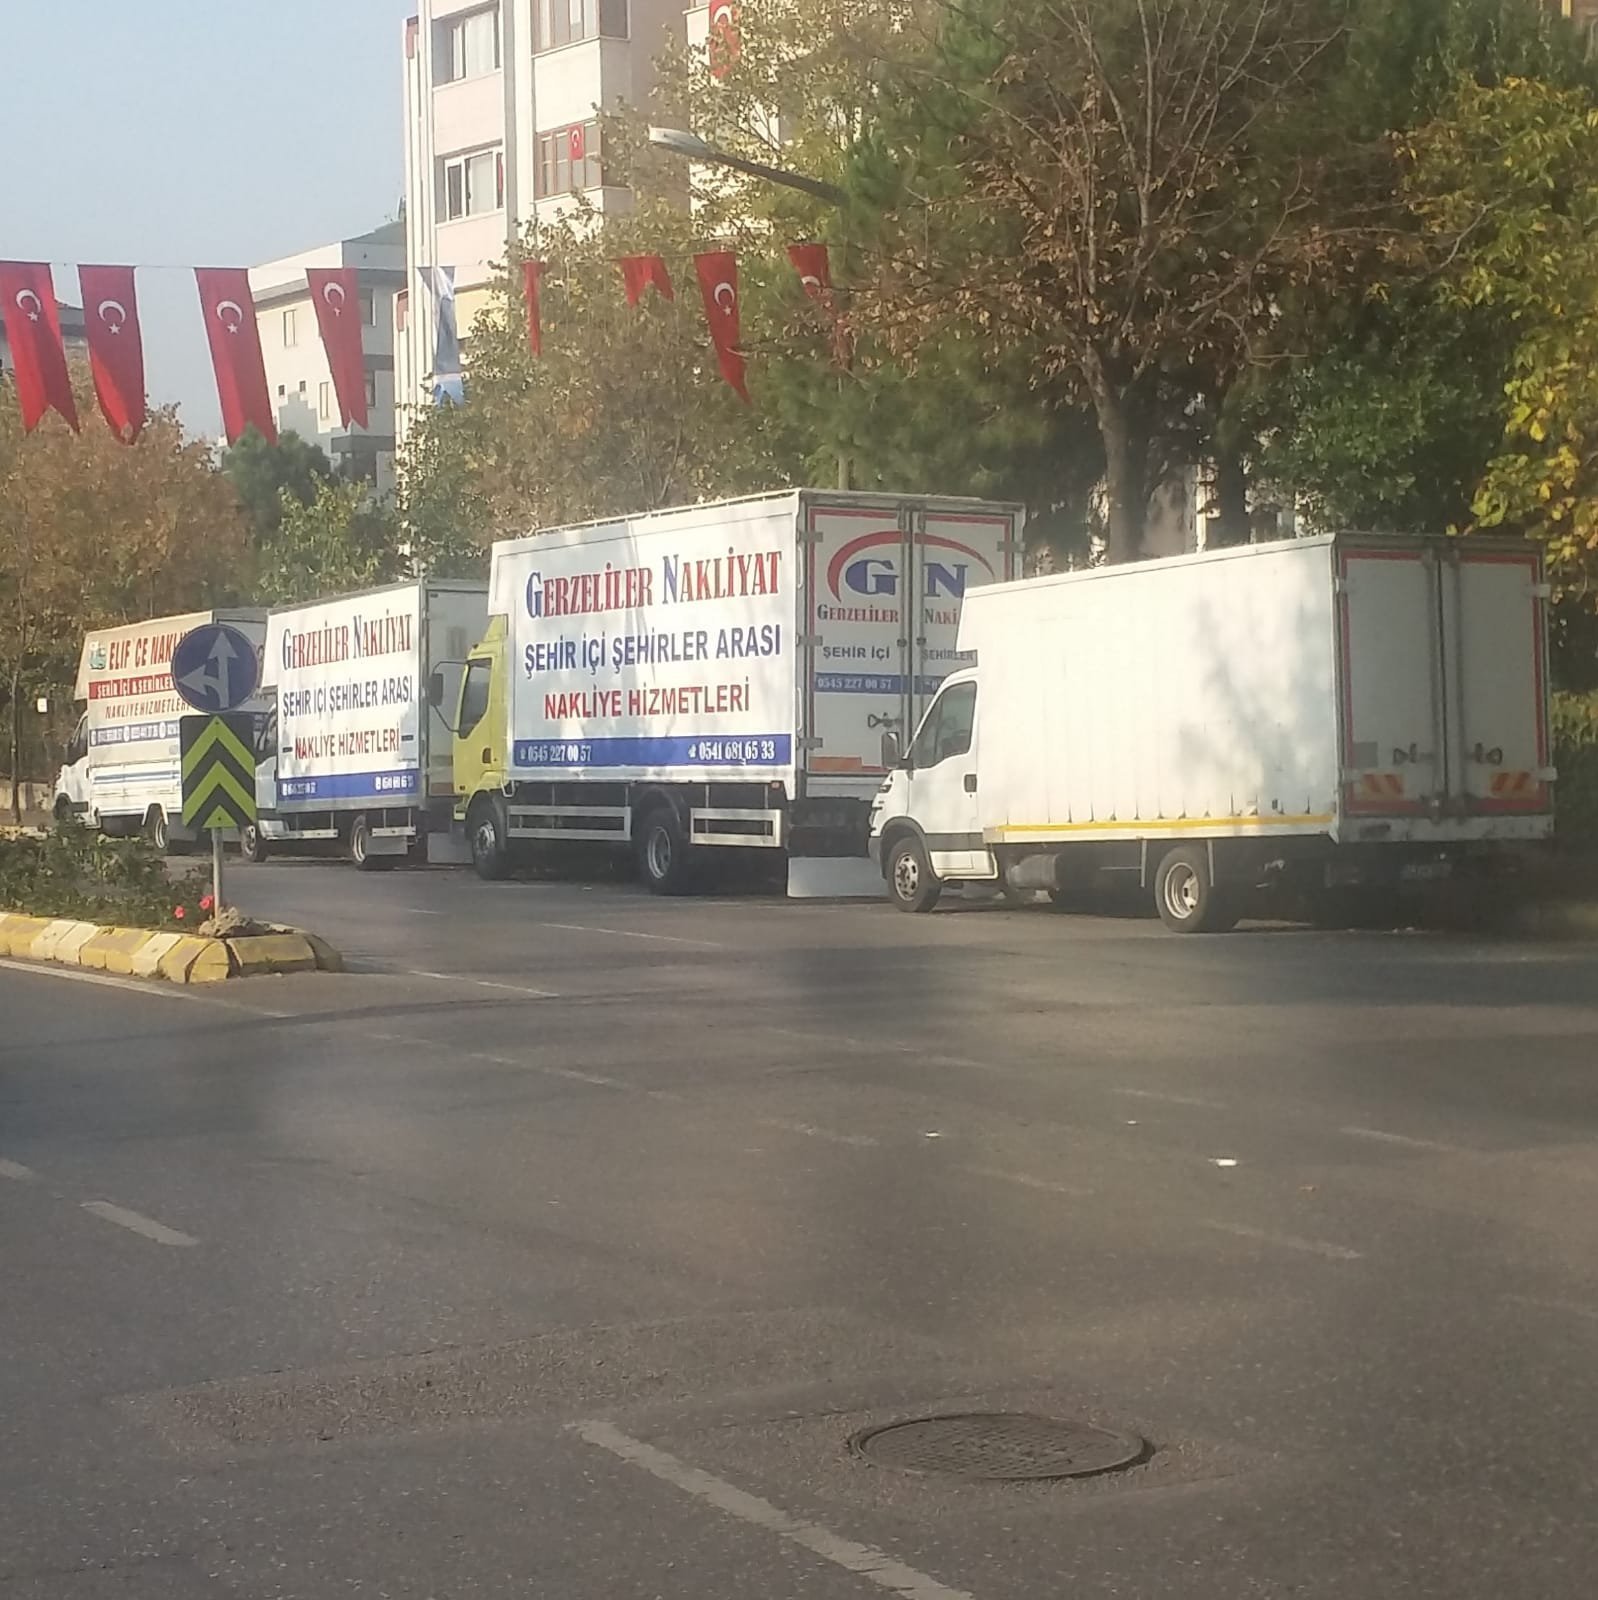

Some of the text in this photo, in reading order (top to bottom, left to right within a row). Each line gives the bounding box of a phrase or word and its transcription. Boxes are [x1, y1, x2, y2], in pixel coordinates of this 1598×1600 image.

[526, 547, 782, 619] GERZELİLER NAKLİYAT
[845, 559, 968, 598] G N
[283, 609, 413, 670] GERZELİLER NAKLİYAT
[525, 624, 781, 680] ŞEHİR İÇİ ŞEHİRLER ARASI
[823, 645, 866, 660] ŞEHİR
[382, 675, 413, 706] ARASI
[545, 676, 749, 720] NAKLİYE HİZMETLERİ
[295, 720, 400, 761] NAKLİYE HİZMETLERİ
[527, 744, 592, 762] 0545 227 00 57
[699, 741, 723, 760] 0541
[724, 740, 743, 760] 681
[760, 739, 775, 760] 33
